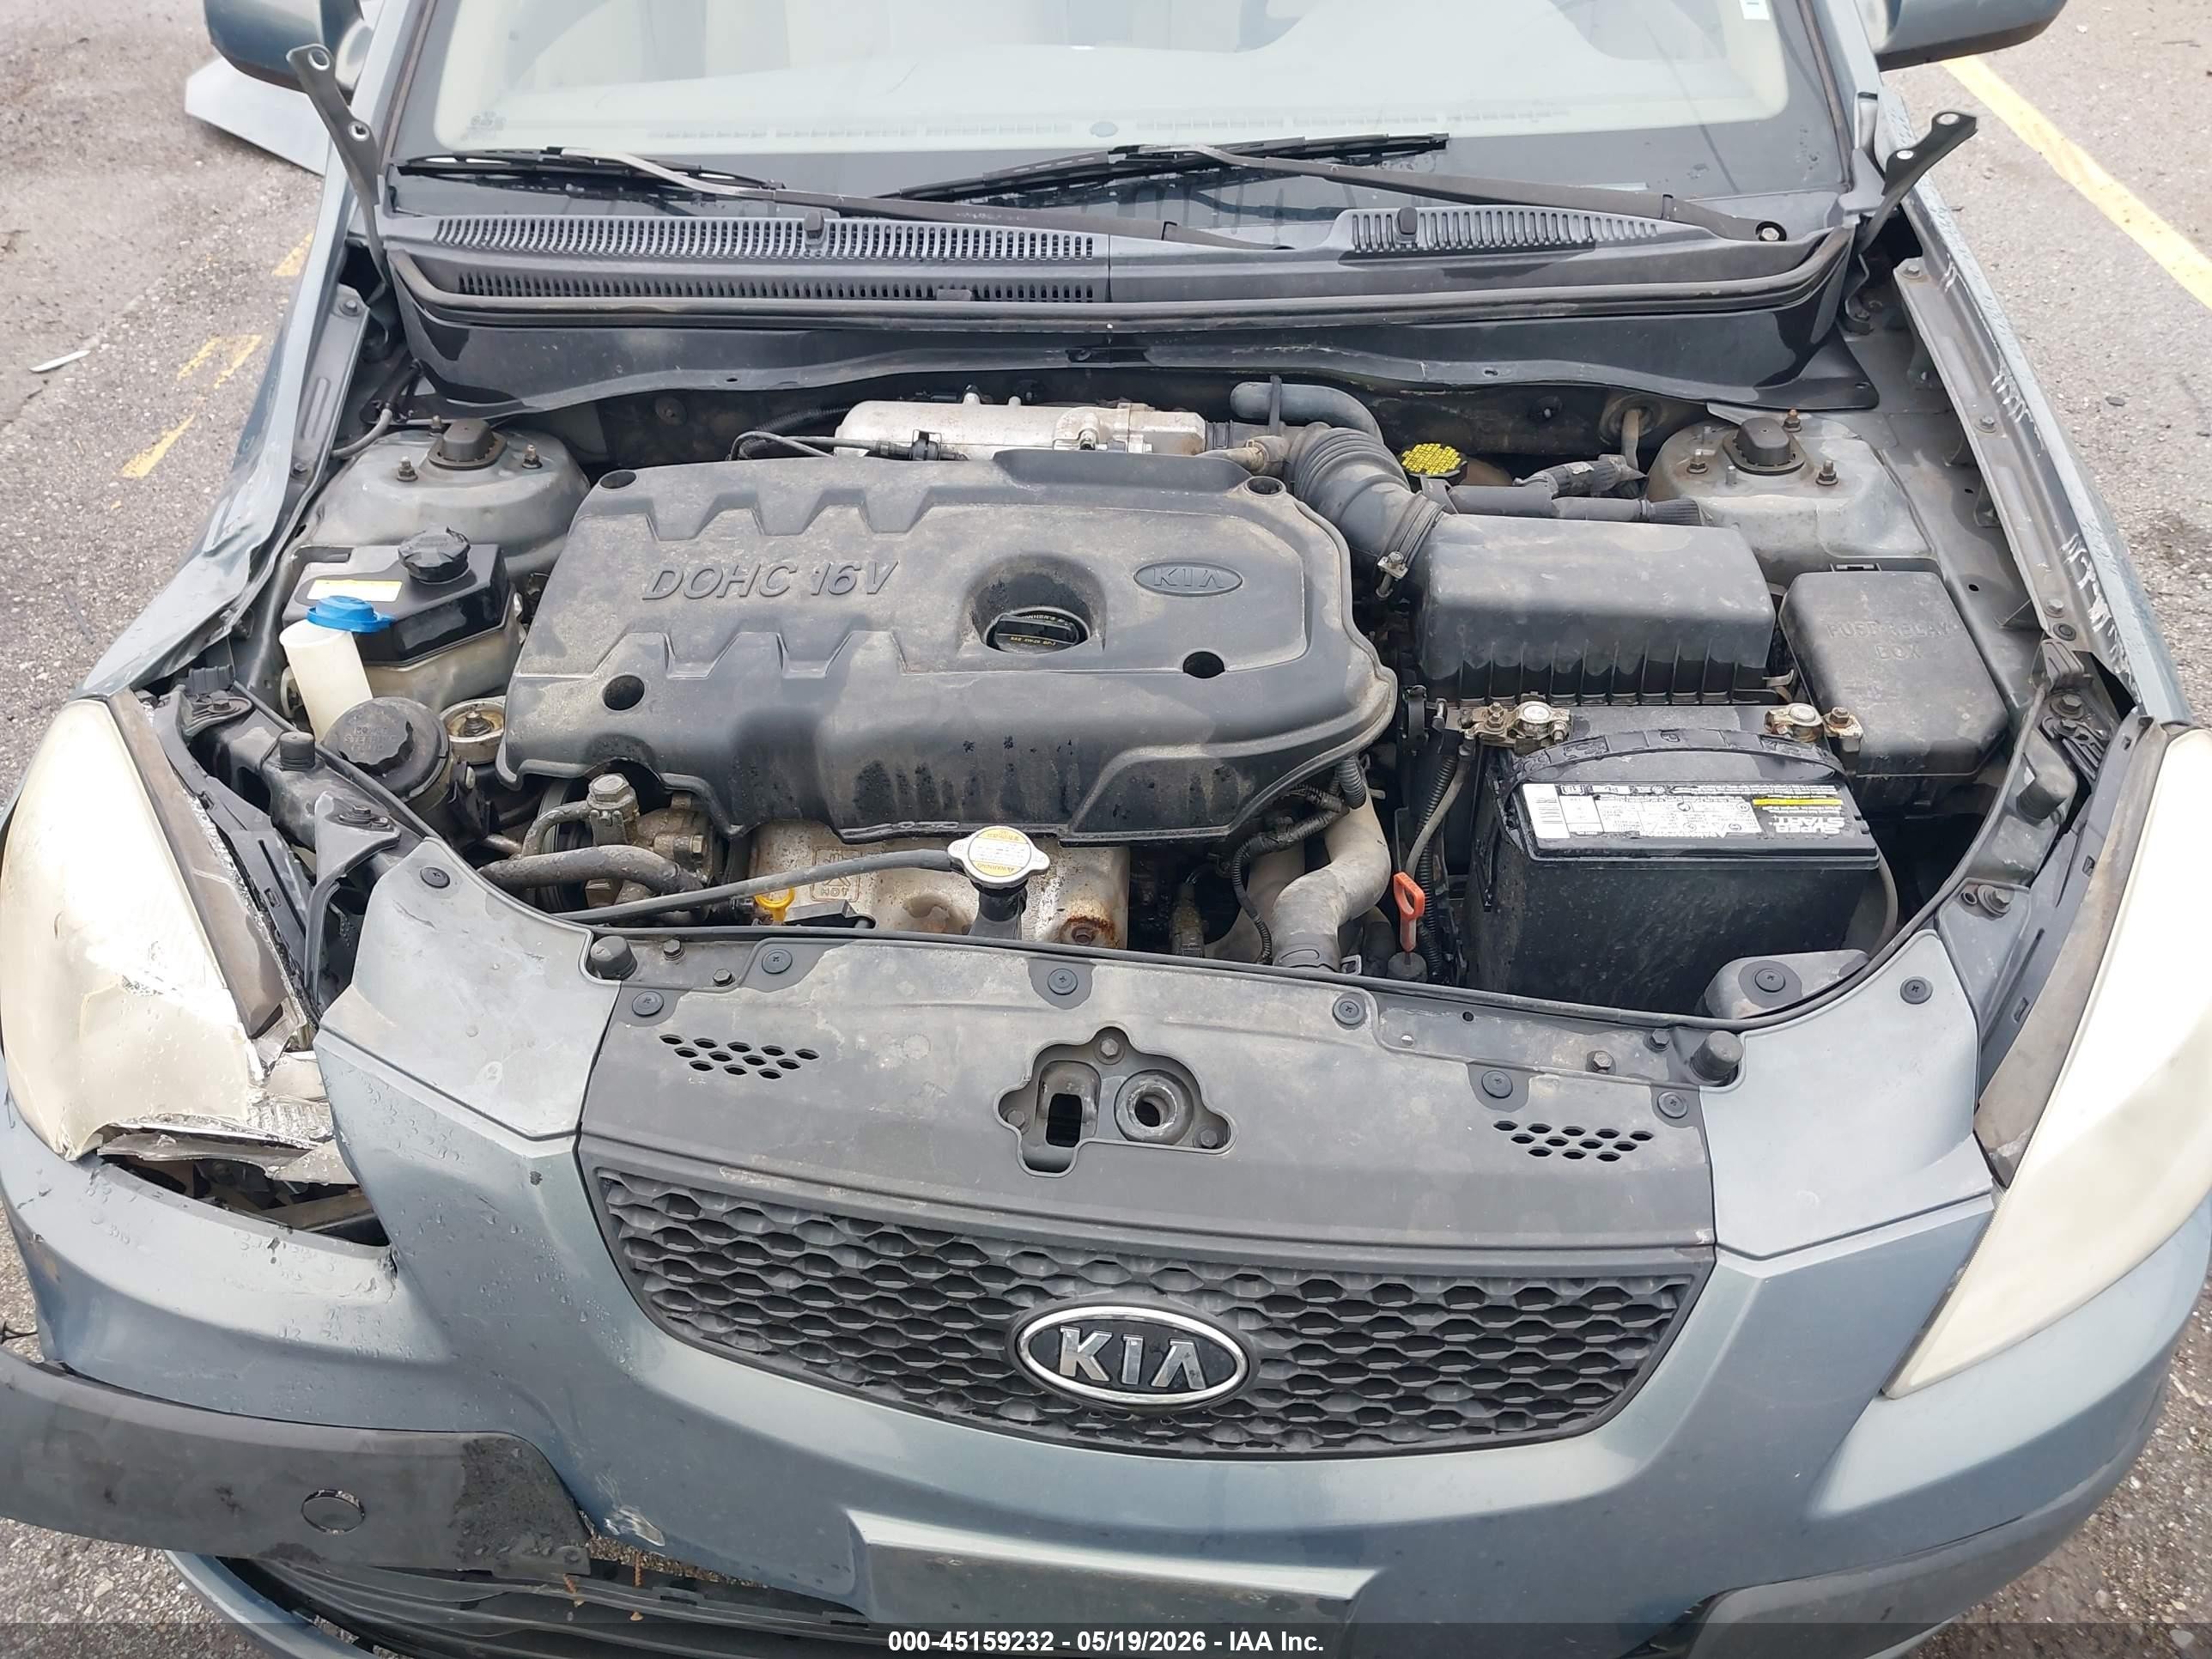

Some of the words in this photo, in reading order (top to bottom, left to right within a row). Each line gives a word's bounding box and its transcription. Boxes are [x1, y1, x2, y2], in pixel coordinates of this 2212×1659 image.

[642, 560, 798, 600] DOHC
[811, 560, 899, 597] 16V
[1152, 567, 1225, 589] KIA
[1773, 817, 1845, 829] START
[1774, 824, 1841, 836] SUPER
[821, 887, 849, 896] HOT
[1059, 1326, 1206, 1390] KIA
